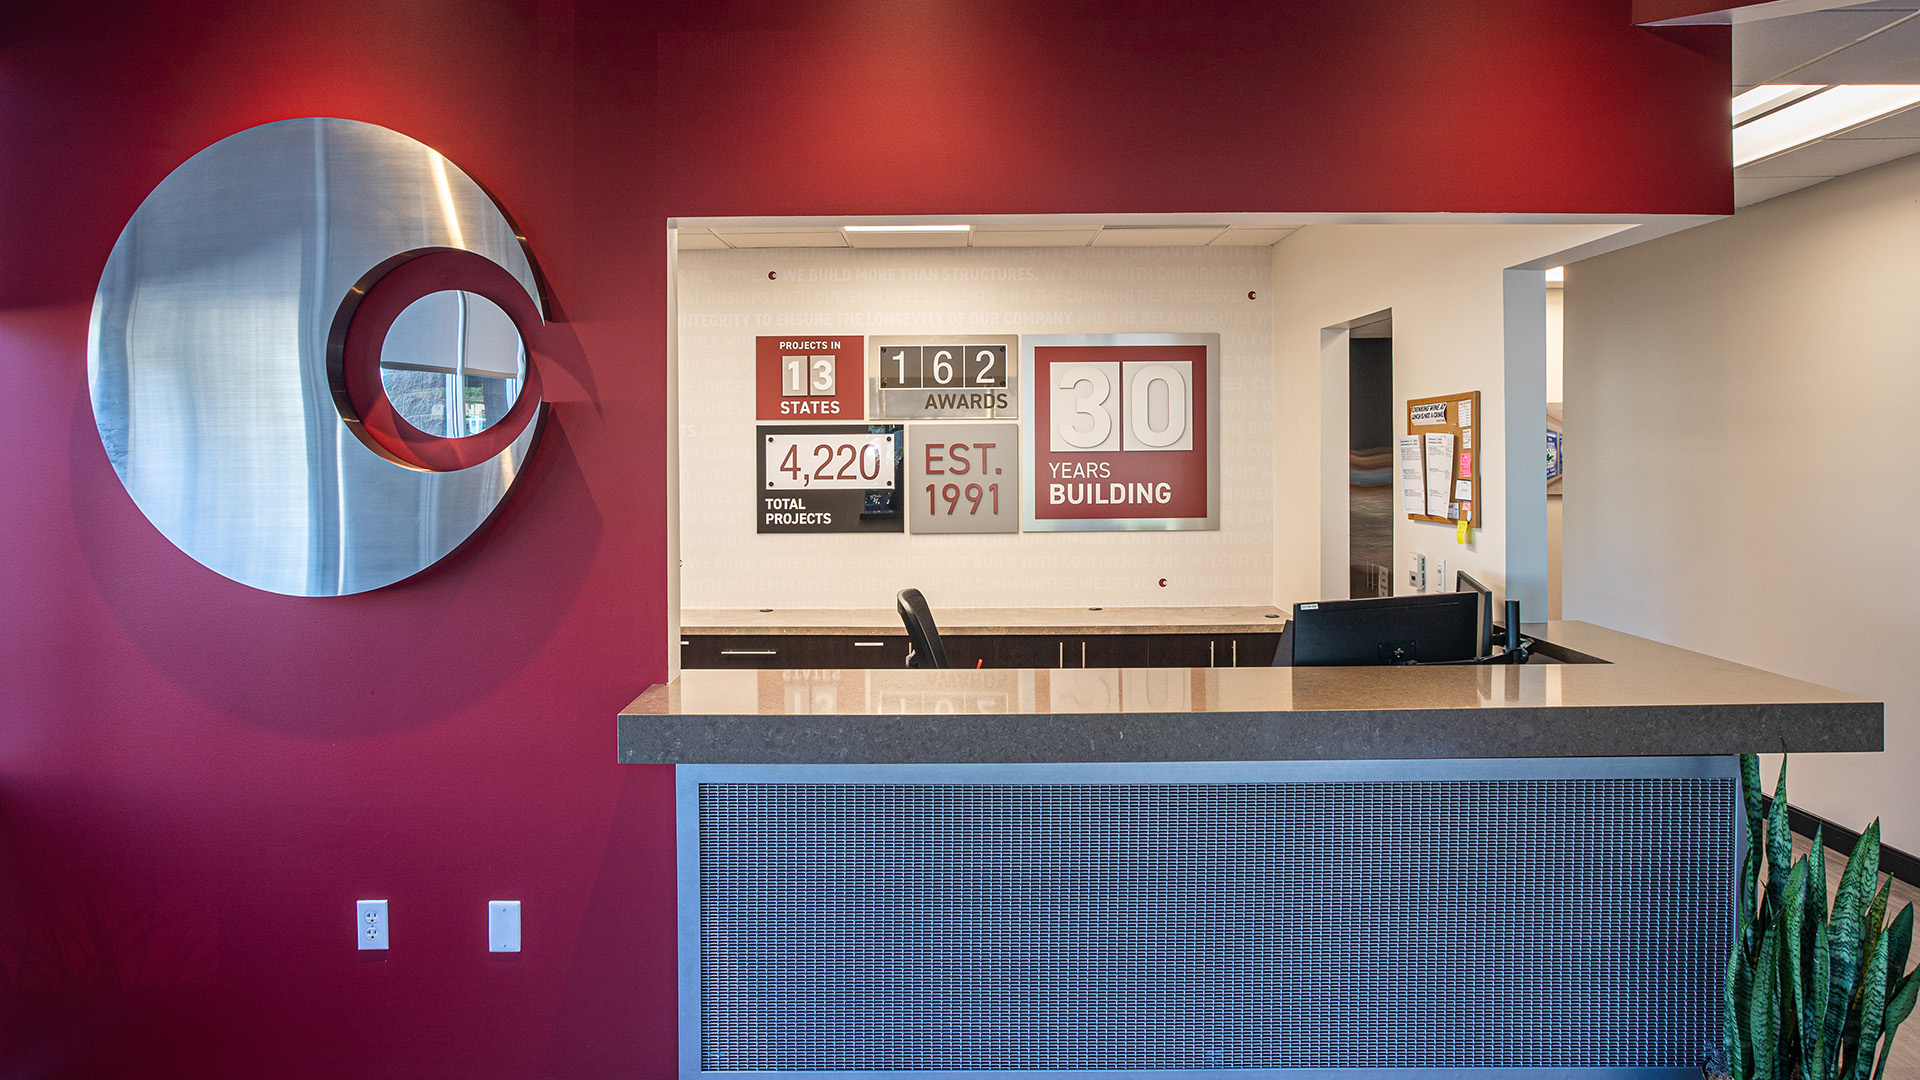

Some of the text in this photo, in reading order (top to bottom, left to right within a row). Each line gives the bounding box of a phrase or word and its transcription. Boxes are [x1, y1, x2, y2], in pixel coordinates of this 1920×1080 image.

[782, 268, 805, 282] WE
[809, 268, 851, 282] BUILD
[855, 268, 896, 282] MORE
[899, 268, 938, 282] THAN
[942, 267, 1039, 281] STRUCTURES.
[679, 314, 751, 328] INTEGRITY
[755, 314, 773, 328] TO
[776, 313, 833, 327] ENSURE
[836, 313, 863, 327] THE
[867, 313, 944, 327] LONGEVITY
[948, 313, 966, 327] OF
[970, 312, 999, 326] OUR
[1004, 312, 1073, 326] COMPANY
[1076, 312, 1106, 326] AND
[1111, 312, 1137, 326] THE
[779, 341, 841, 350] PROJECTS IN
[787, 360, 833, 391] 13
[892, 350, 995, 385] 162
[780, 401, 841, 415] STATES
[924, 393, 1009, 410] AWARDS
[1058, 365, 1187, 449] 30
[779, 444, 881, 487] 4,220
[926, 443, 1002, 475] EST.
[1049, 462, 1111, 479] YEARS
[926, 483, 998, 515] 1991
[1050, 482, 1172, 505] BUILDING
[765, 499, 806, 510] TOTAL
[766, 513, 832, 525] PROJECTS
